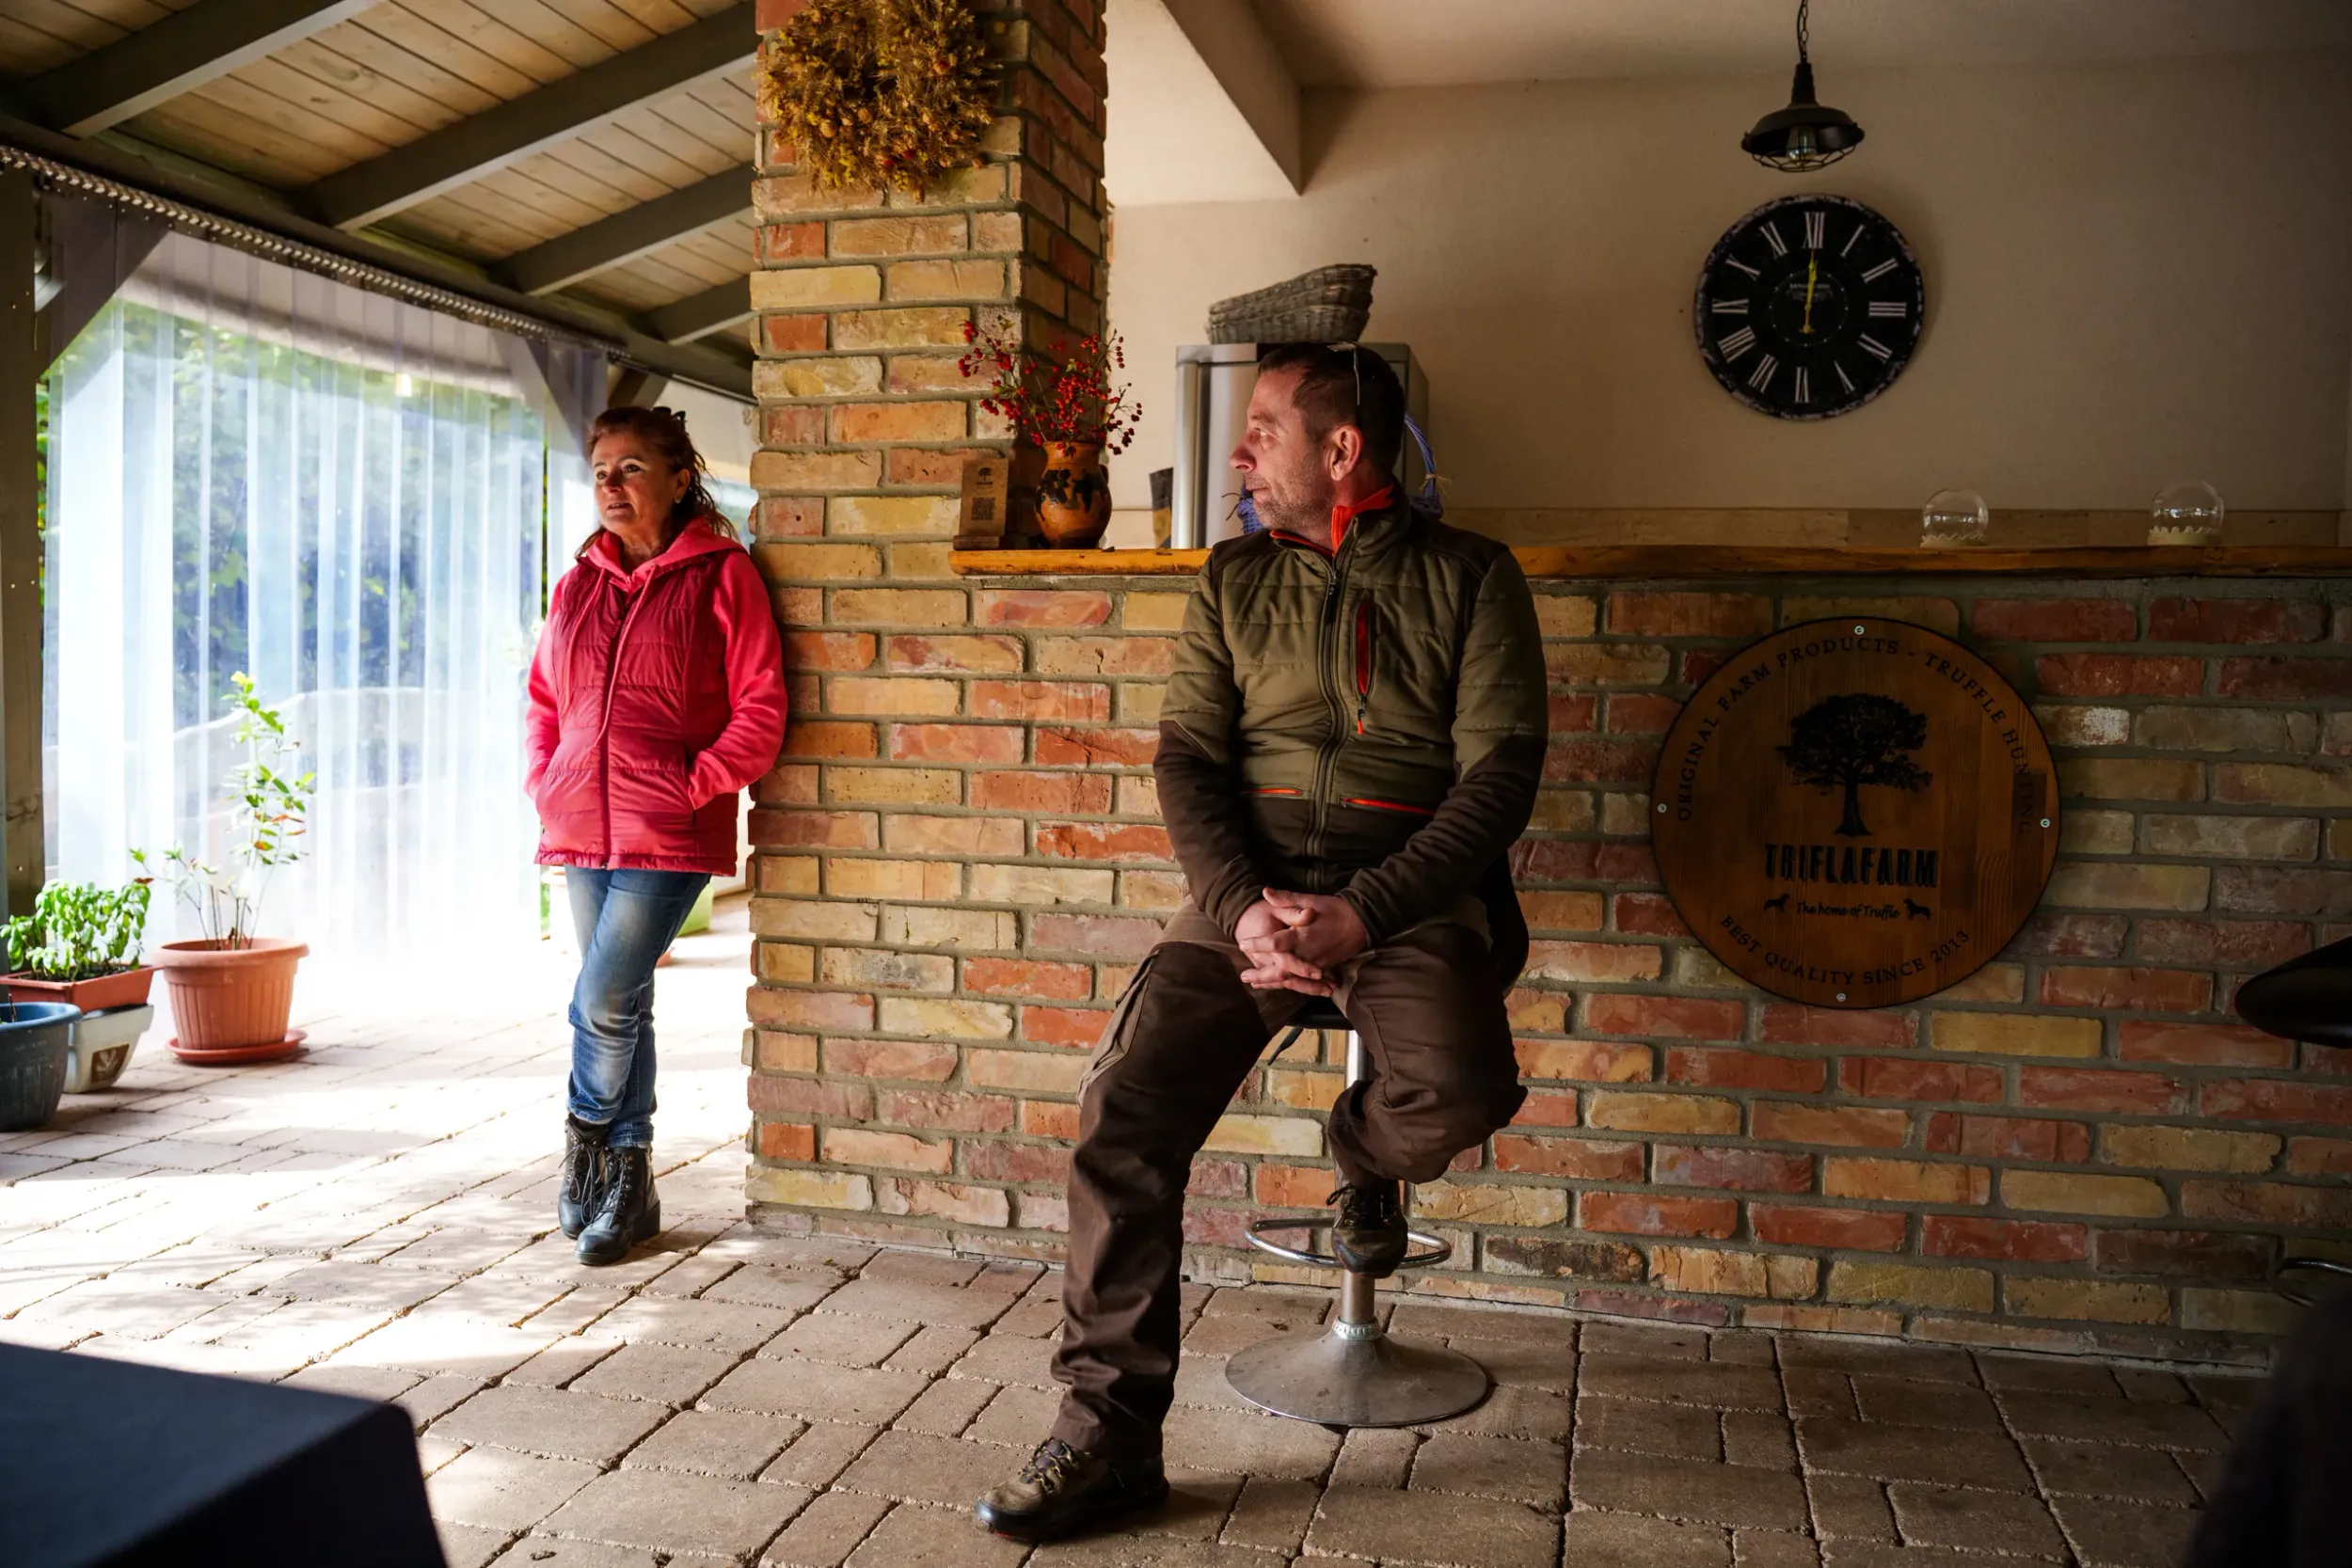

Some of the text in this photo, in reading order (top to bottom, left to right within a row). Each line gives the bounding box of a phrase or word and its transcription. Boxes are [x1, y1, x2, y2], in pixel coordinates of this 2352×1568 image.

[1757, 221, 1788, 259] XI
[1803, 212, 1825, 248] XII
[1725, 254, 1761, 281] X
[1860, 257, 1899, 283] II
[1711, 298, 1749, 313] IX
[1868, 302, 1907, 318] III
[1717, 325, 1756, 363] VIII
[1856, 332, 1893, 363] IV
[1747, 354, 1779, 393] VII
[1795, 367, 1809, 403] VI
[1834, 359, 1855, 394] V
[1678, 717, 1719, 821] ORIGINAL
[1717, 663, 1771, 711] FARM
[1777, 637, 1899, 668] PRODUCTS
[1925, 653, 2006, 723] TRUFFLE
[2003, 729, 2034, 835] HUNTING
[1765, 844, 1938, 887] TRIFLAFARM
[1796, 900, 1900, 919] The home of Truffle
[1720, 915, 1970, 986] BEST QUALITY SINCE 2013
